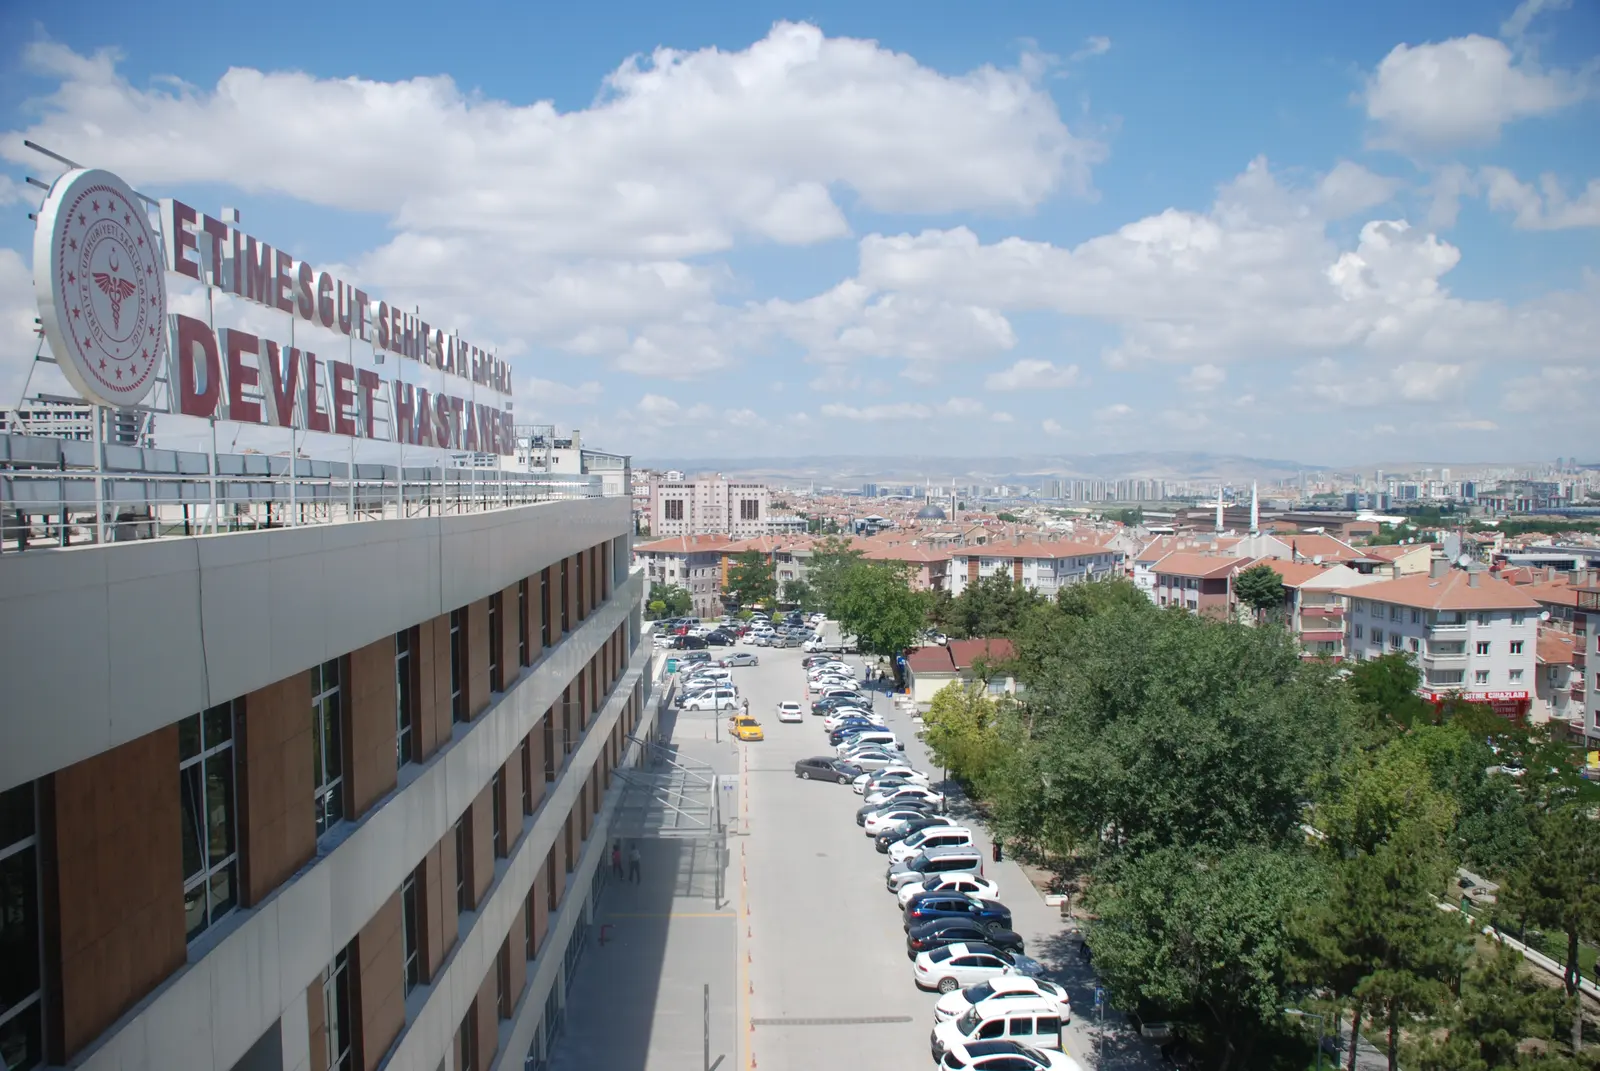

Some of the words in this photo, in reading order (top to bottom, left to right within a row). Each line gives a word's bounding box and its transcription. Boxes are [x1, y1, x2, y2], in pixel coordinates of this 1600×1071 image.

[81, 223, 119, 278] CUMHURİYETİ
[119, 231, 142, 272] SAĞLIK
[162, 198, 371, 343] ETİMESGUT
[429, 328, 469, 381] SAİT
[170, 314, 379, 438] DEVLET
[394, 380, 513, 456] HASTANESİ
